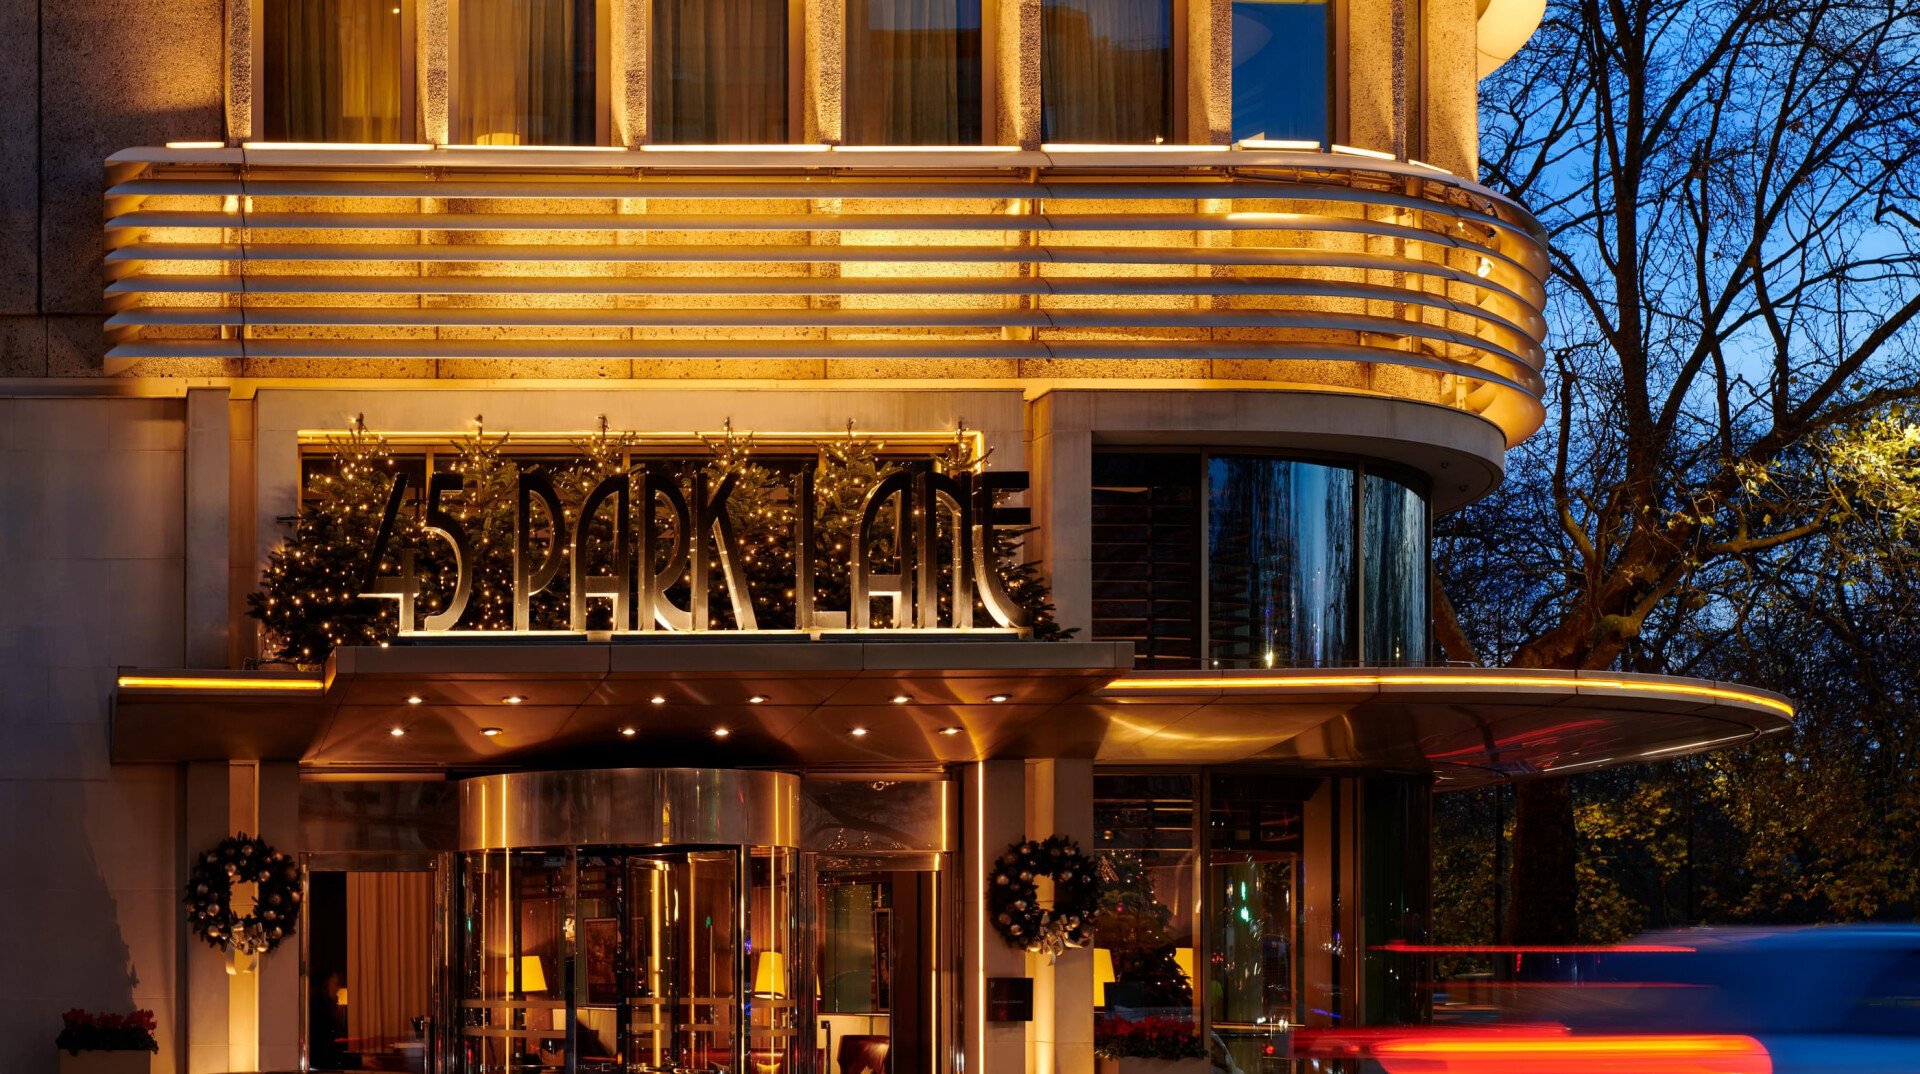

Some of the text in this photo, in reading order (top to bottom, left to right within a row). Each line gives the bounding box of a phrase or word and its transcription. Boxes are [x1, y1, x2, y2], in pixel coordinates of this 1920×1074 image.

[357, 471, 1032, 631] 45 PARK LANE
